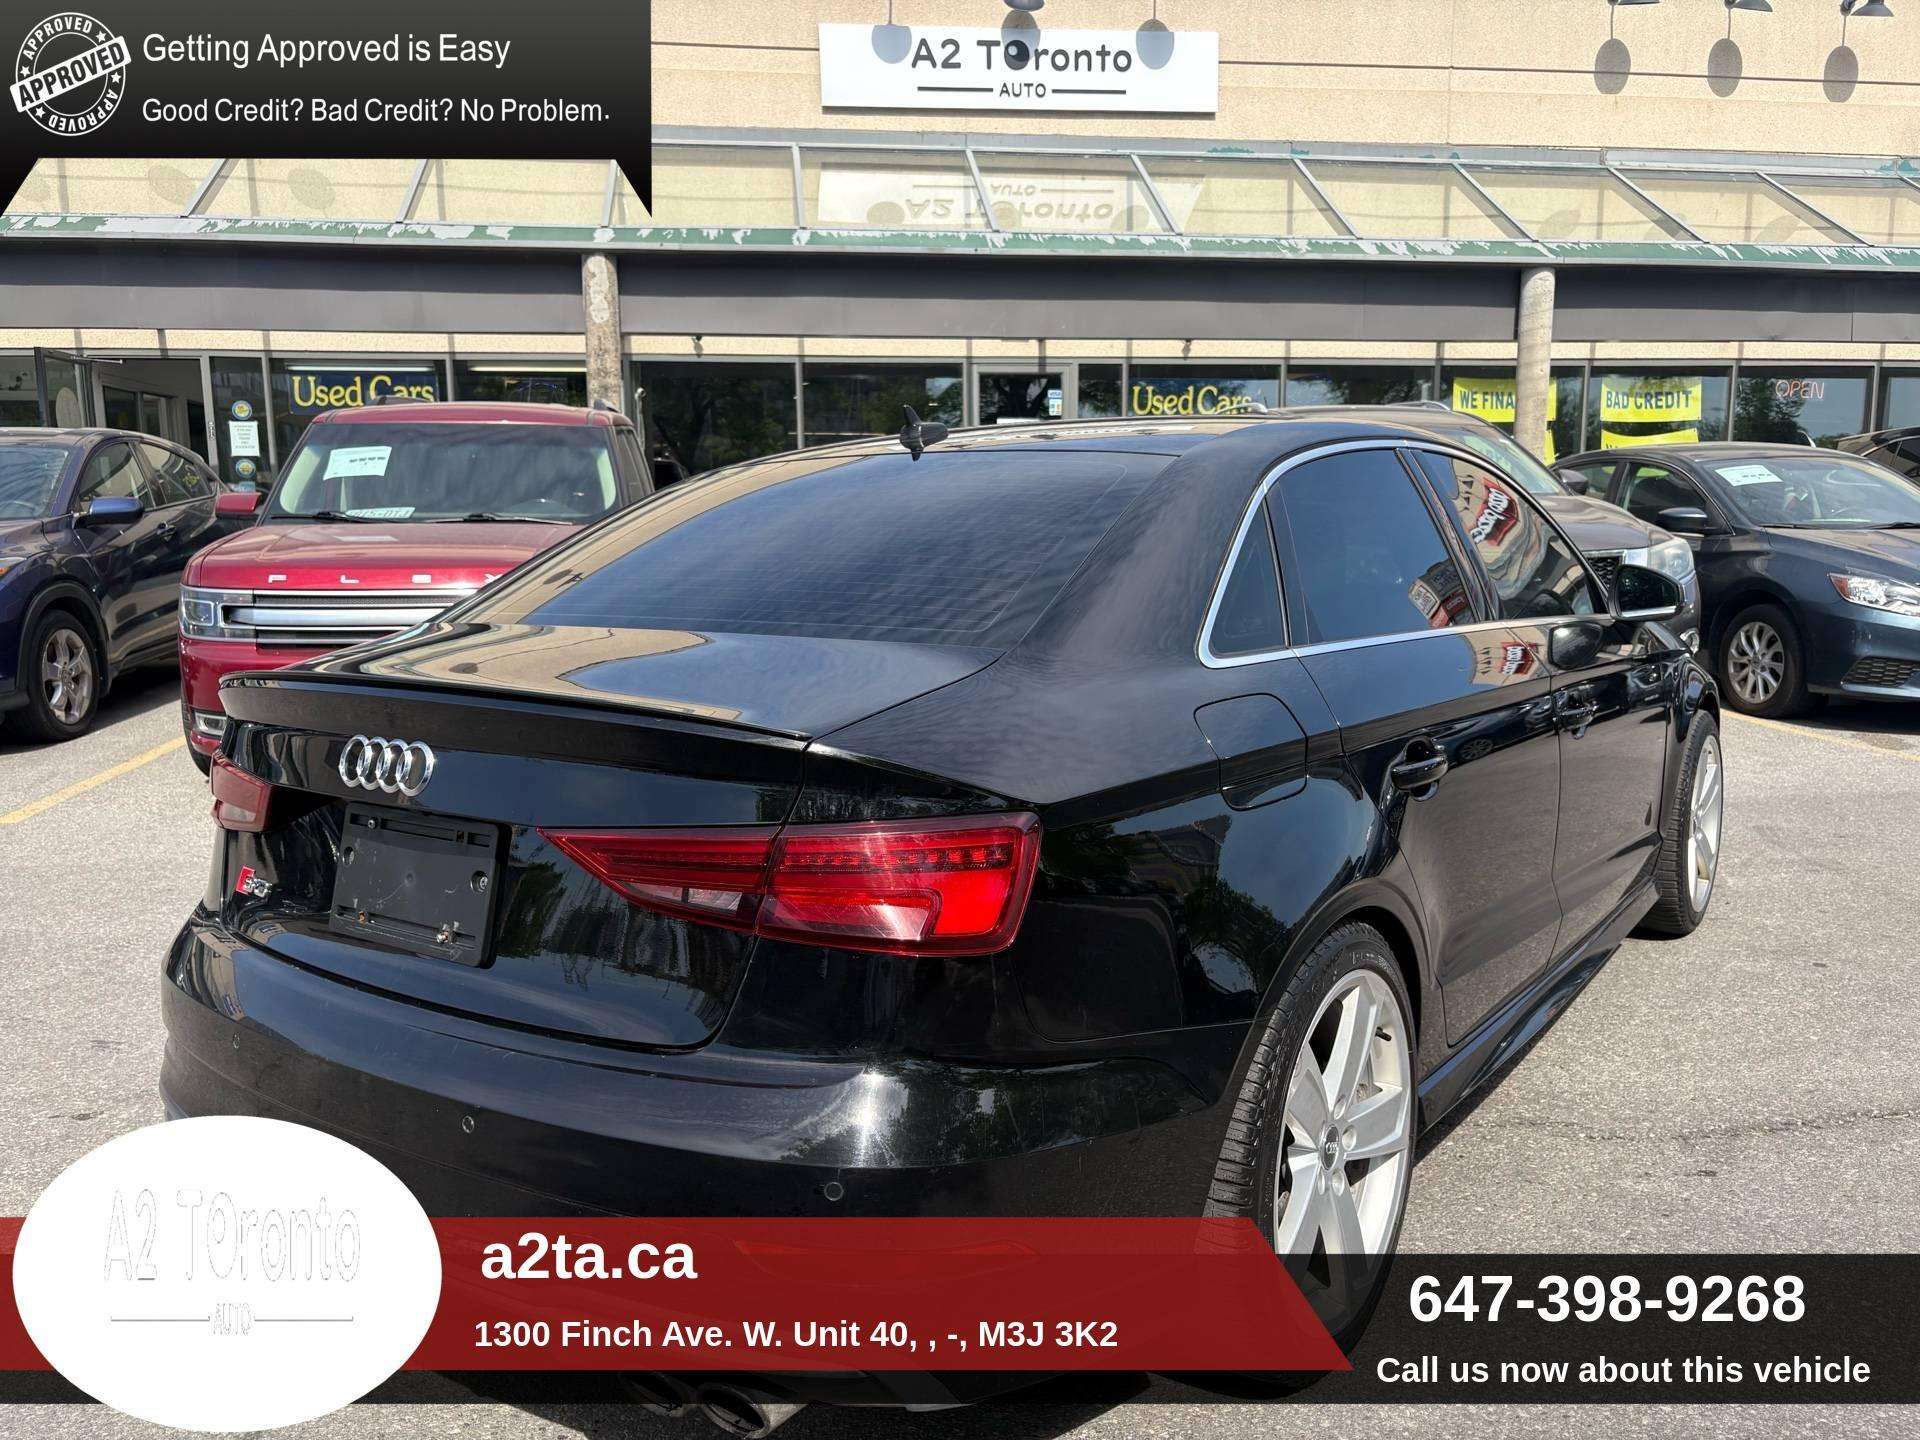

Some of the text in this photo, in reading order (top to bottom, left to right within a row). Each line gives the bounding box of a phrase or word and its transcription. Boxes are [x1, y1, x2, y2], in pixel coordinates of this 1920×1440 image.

[911, 38, 962, 69] A2
[999, 82, 1047, 98] AUTO
[292, 375, 364, 407] Used
[1606, 389, 1692, 409] BAD CREDIT
[1775, 380, 1825, 399] OPEN
[1132, 385, 1194, 415] Used
[1460, 391, 1478, 410] WE
